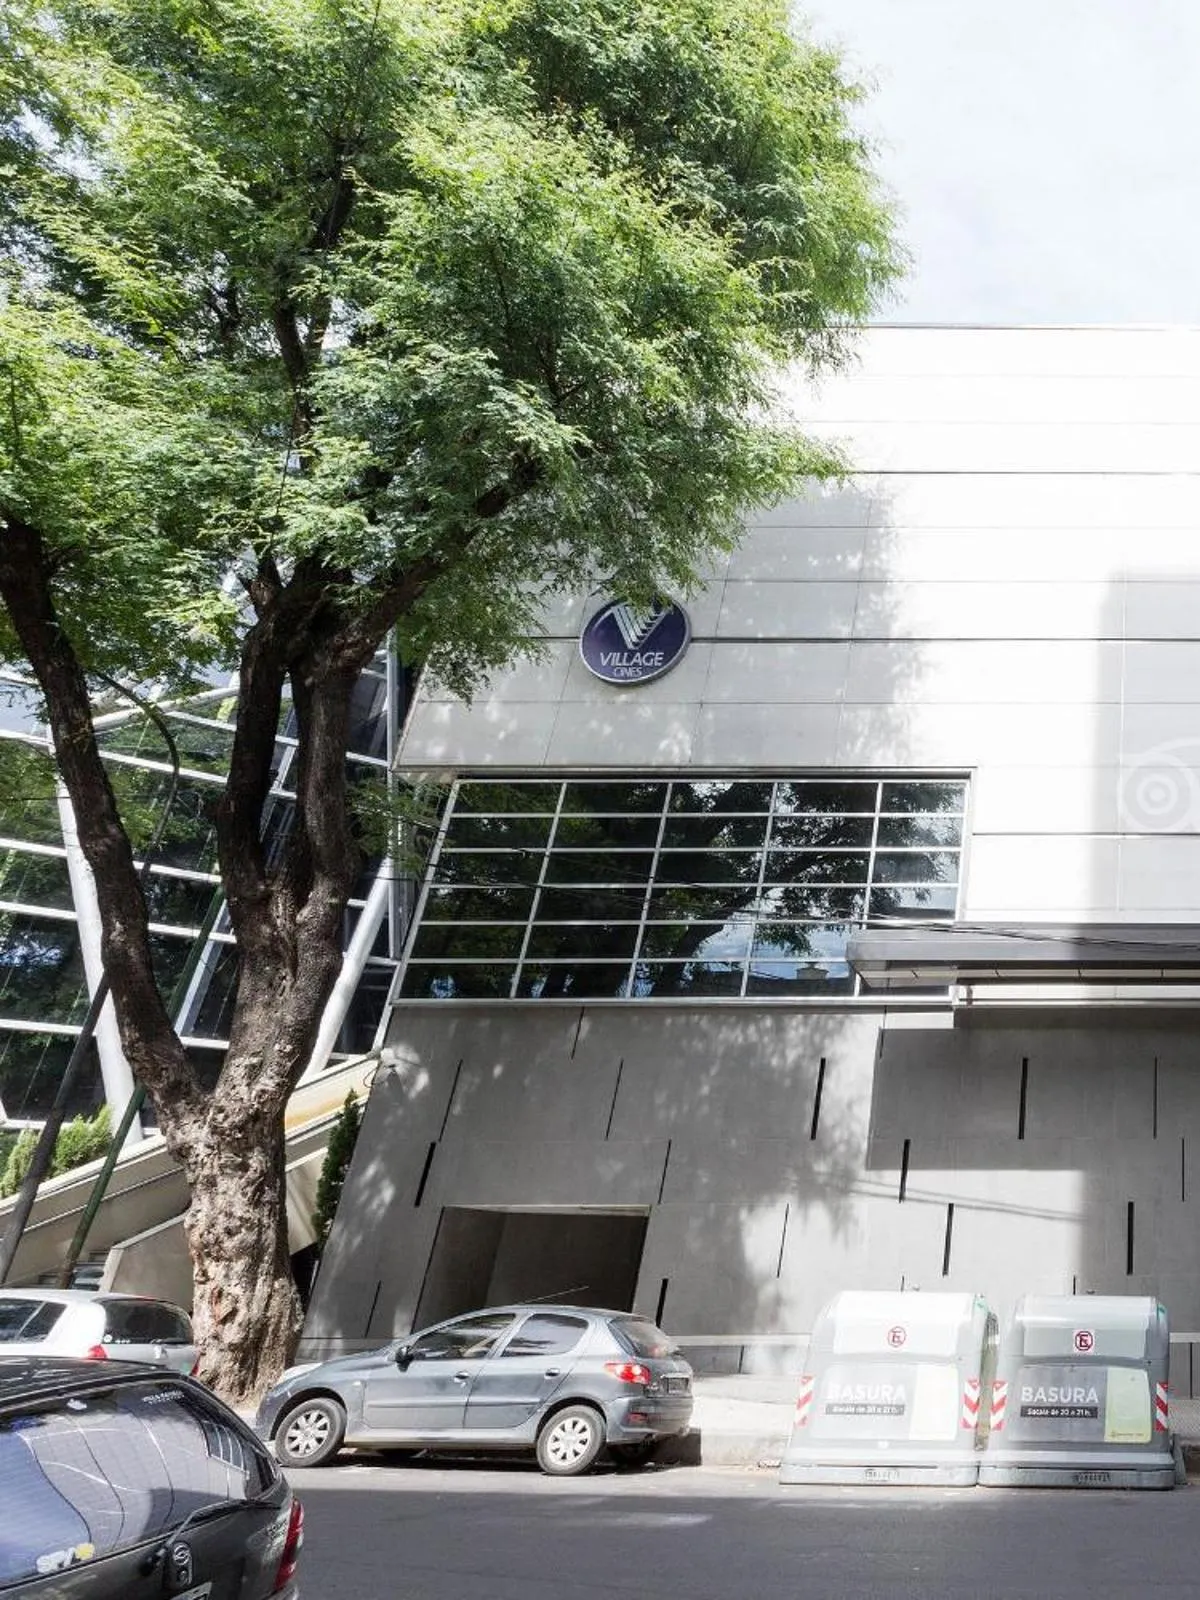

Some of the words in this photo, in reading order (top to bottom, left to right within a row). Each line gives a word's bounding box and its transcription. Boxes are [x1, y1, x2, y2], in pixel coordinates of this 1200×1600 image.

[600, 652, 664, 667] VILLAGE
[613, 667, 642, 677] CINES
[827, 1383, 906, 1403] BASURA
[1021, 1385, 1099, 1403] BASURA
